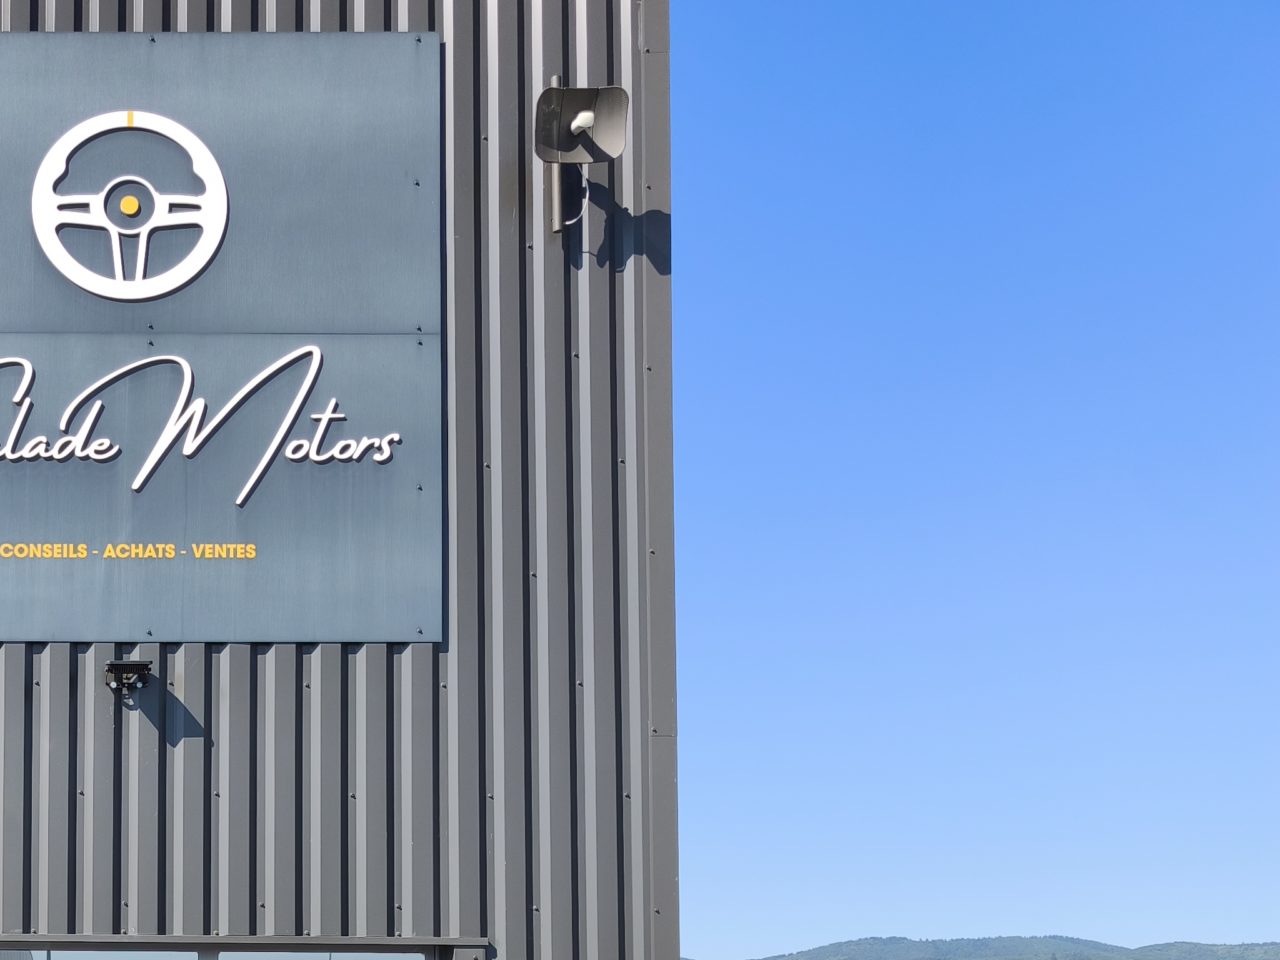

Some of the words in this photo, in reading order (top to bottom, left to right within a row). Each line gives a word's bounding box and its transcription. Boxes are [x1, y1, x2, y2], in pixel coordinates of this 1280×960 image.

[59, 345, 401, 506] Motors
[102, 543, 177, 560] ACHATS
[191, 543, 257, 560] VENTES
